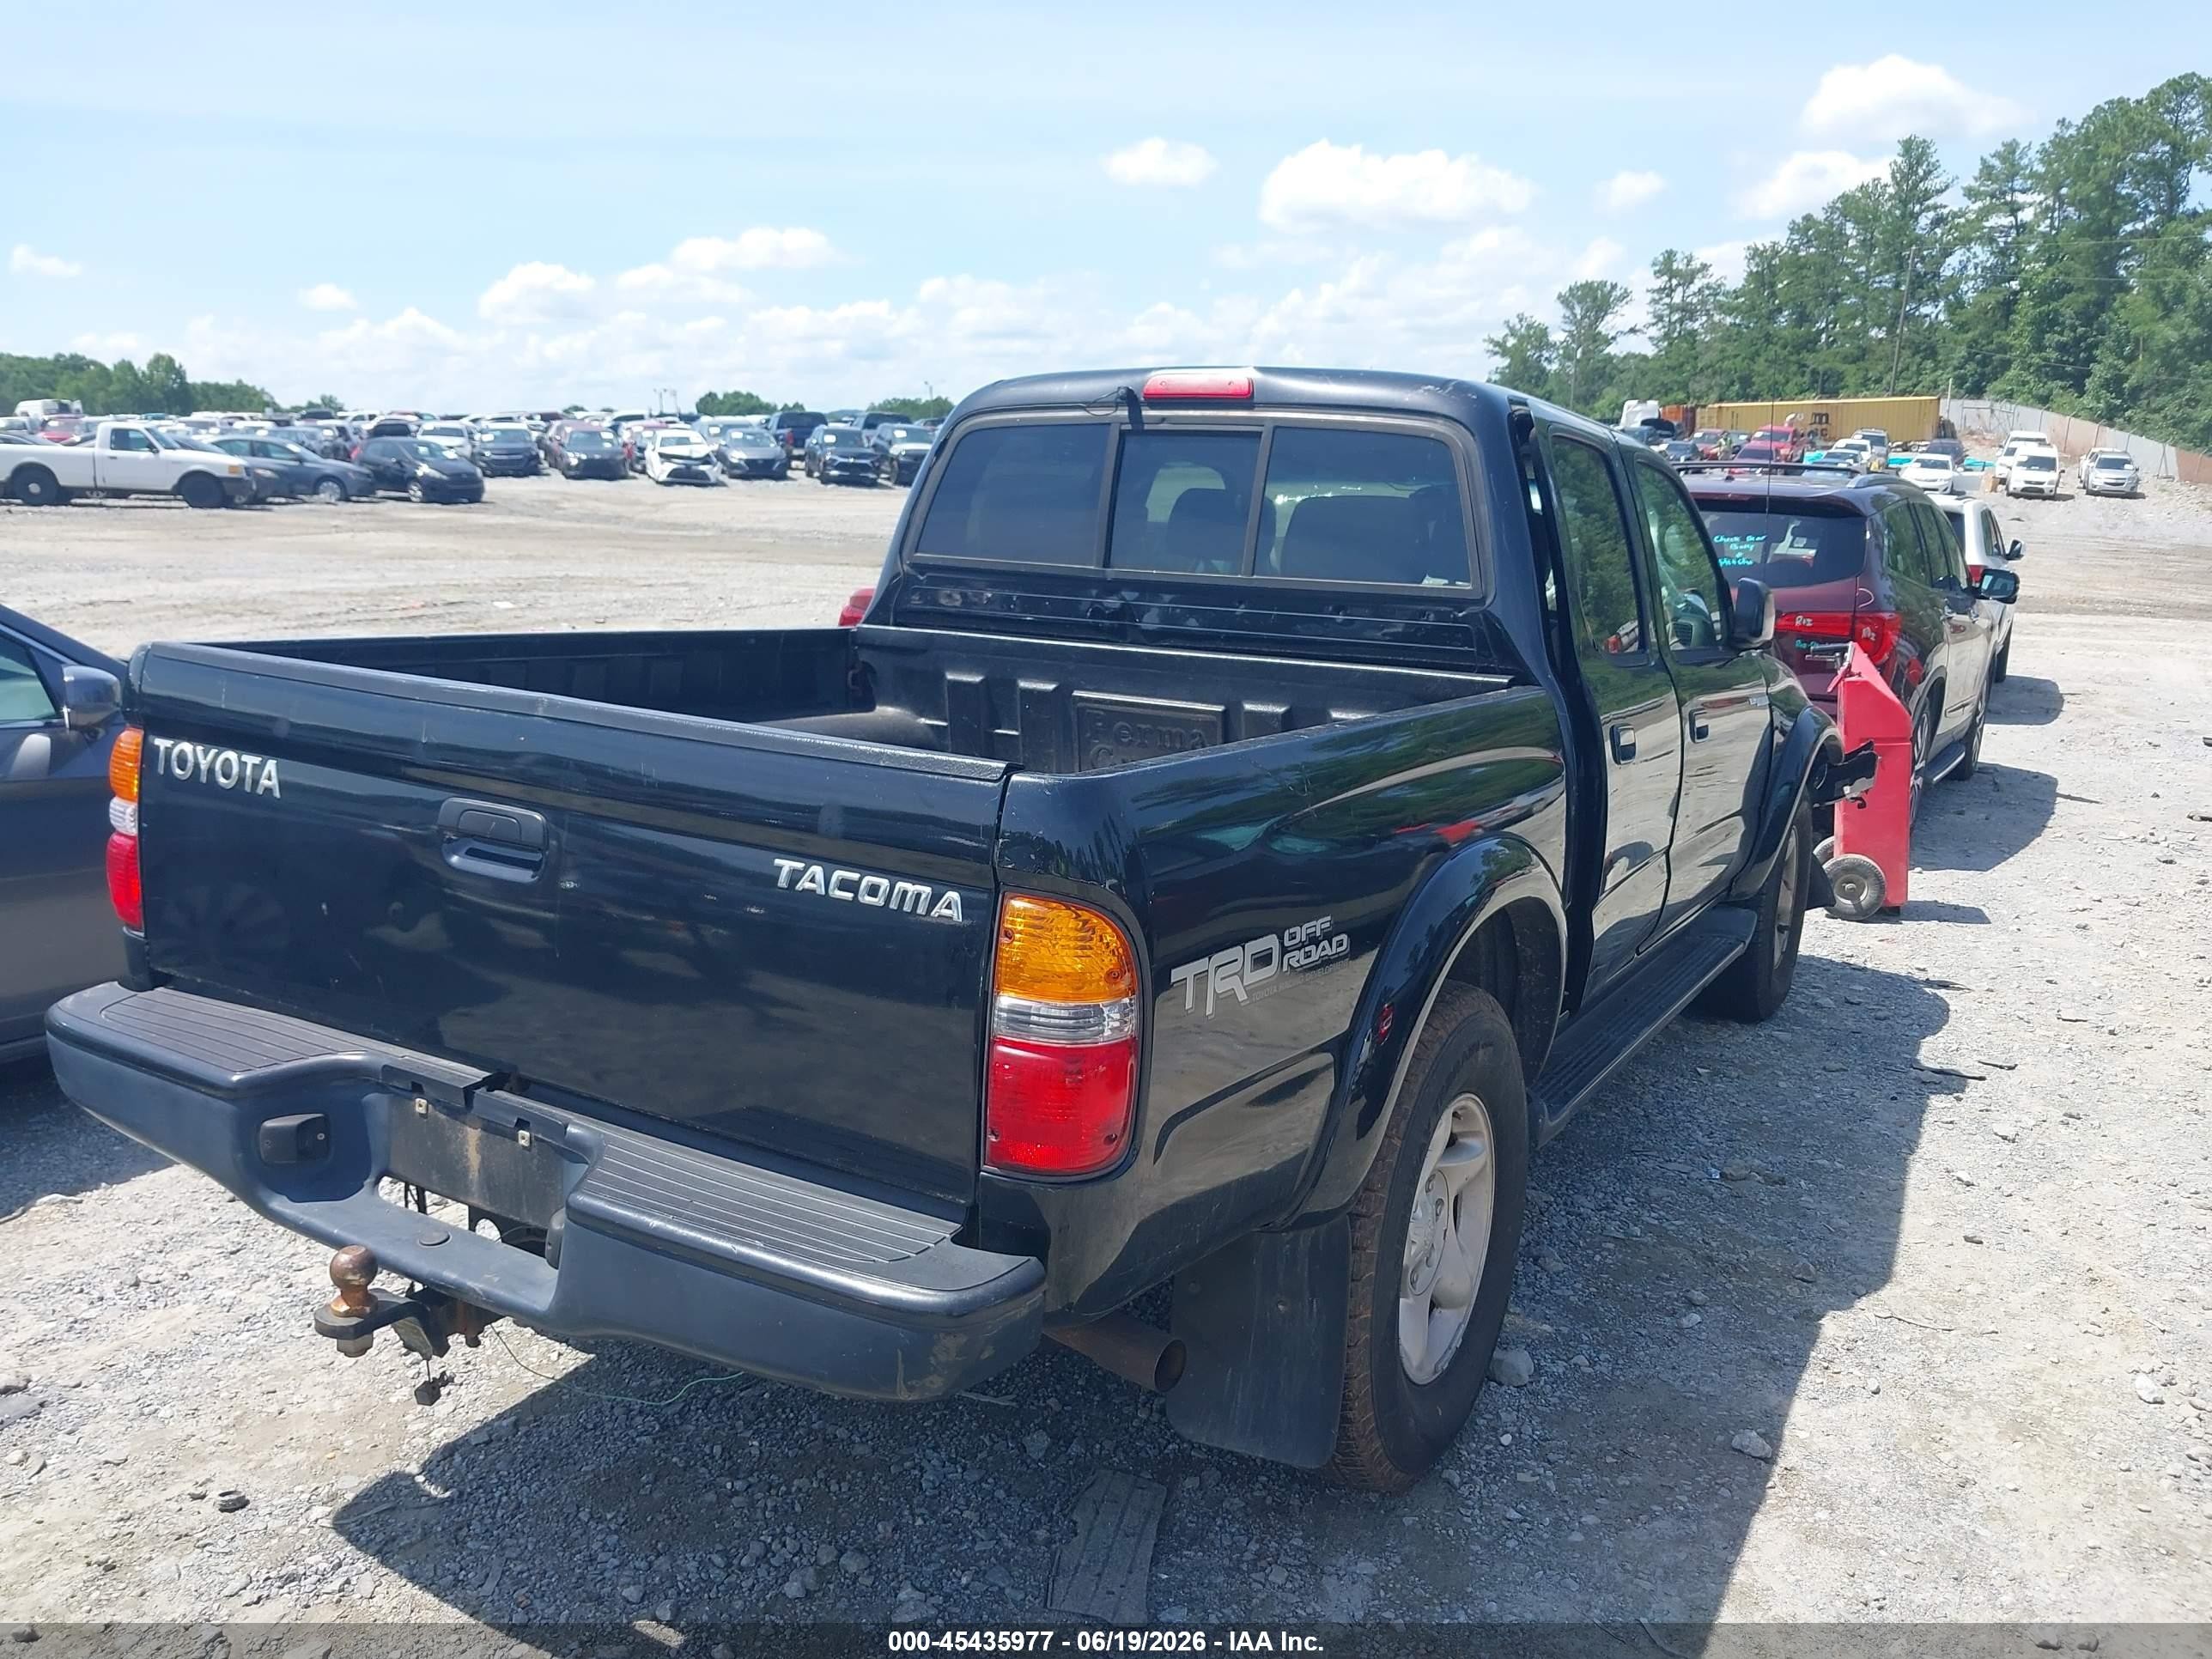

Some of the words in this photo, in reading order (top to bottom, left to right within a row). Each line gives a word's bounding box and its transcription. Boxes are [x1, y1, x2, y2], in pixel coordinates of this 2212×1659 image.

[153, 737, 282, 799] TOYOTA
[773, 857, 963, 923] TACOMA
[1282, 933, 1351, 974] ROAD
[1283, 914, 1333, 949] OFF
[1170, 933, 1280, 1018] TRD
